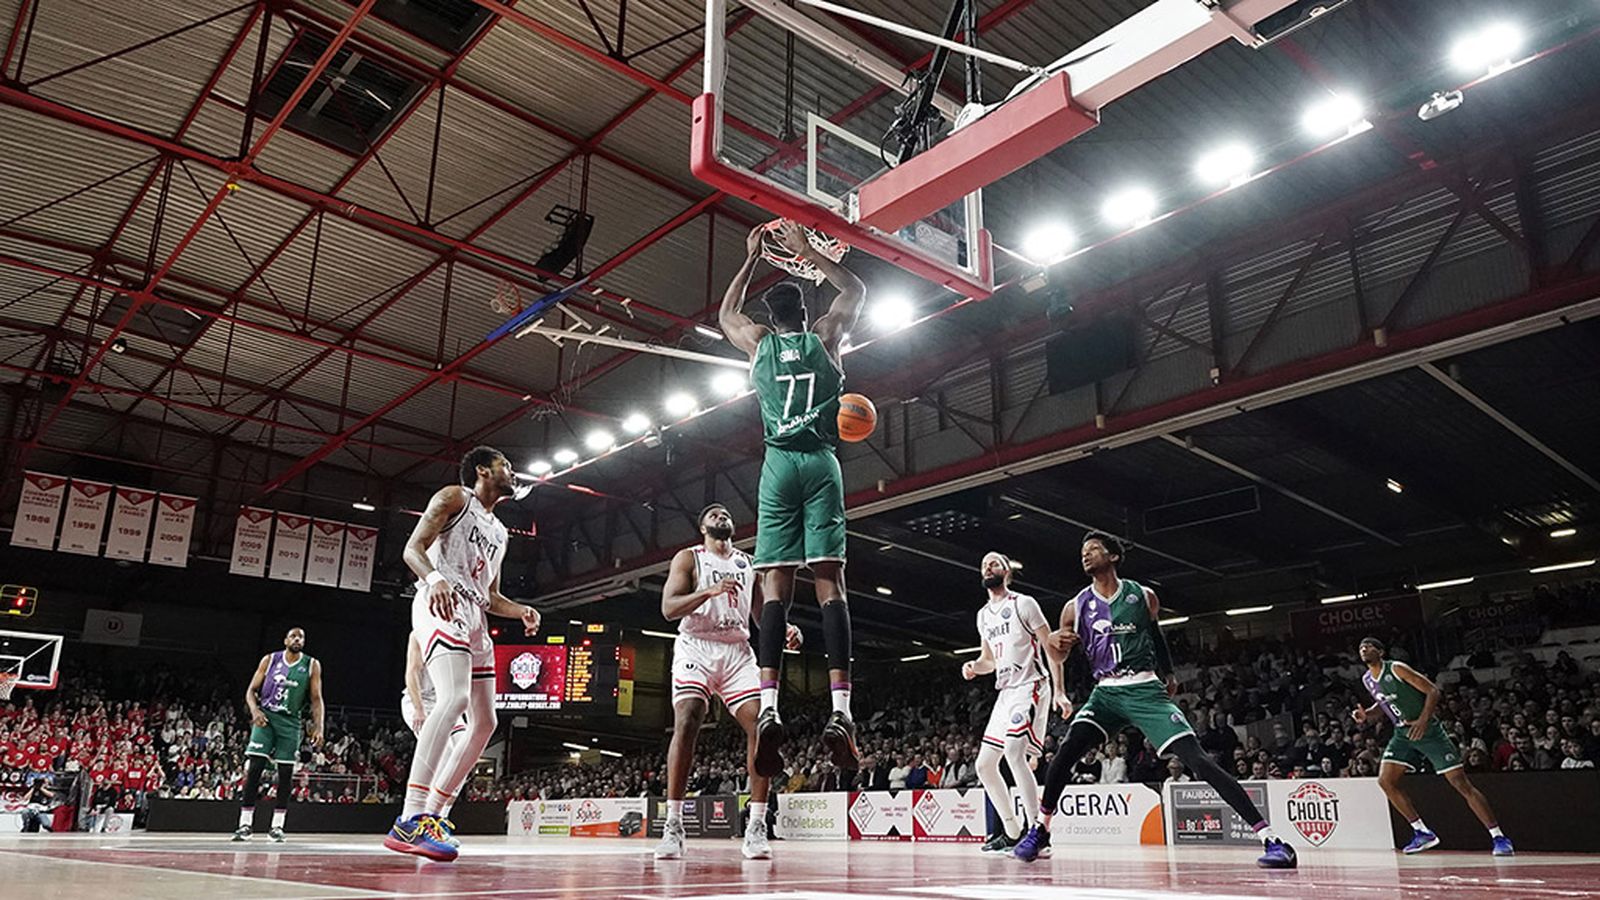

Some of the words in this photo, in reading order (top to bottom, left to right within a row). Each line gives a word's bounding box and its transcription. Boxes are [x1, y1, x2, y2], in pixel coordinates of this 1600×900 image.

[776, 373, 815, 420] 77
[238, 555, 260, 564] 2023
[278, 550, 300, 559] 2010
[1110, 643, 1122, 664] 11
[275, 687, 289, 701] 34
[1287, 799, 1340, 823] CHOLET
[781, 815, 835, 829] Choletaises
